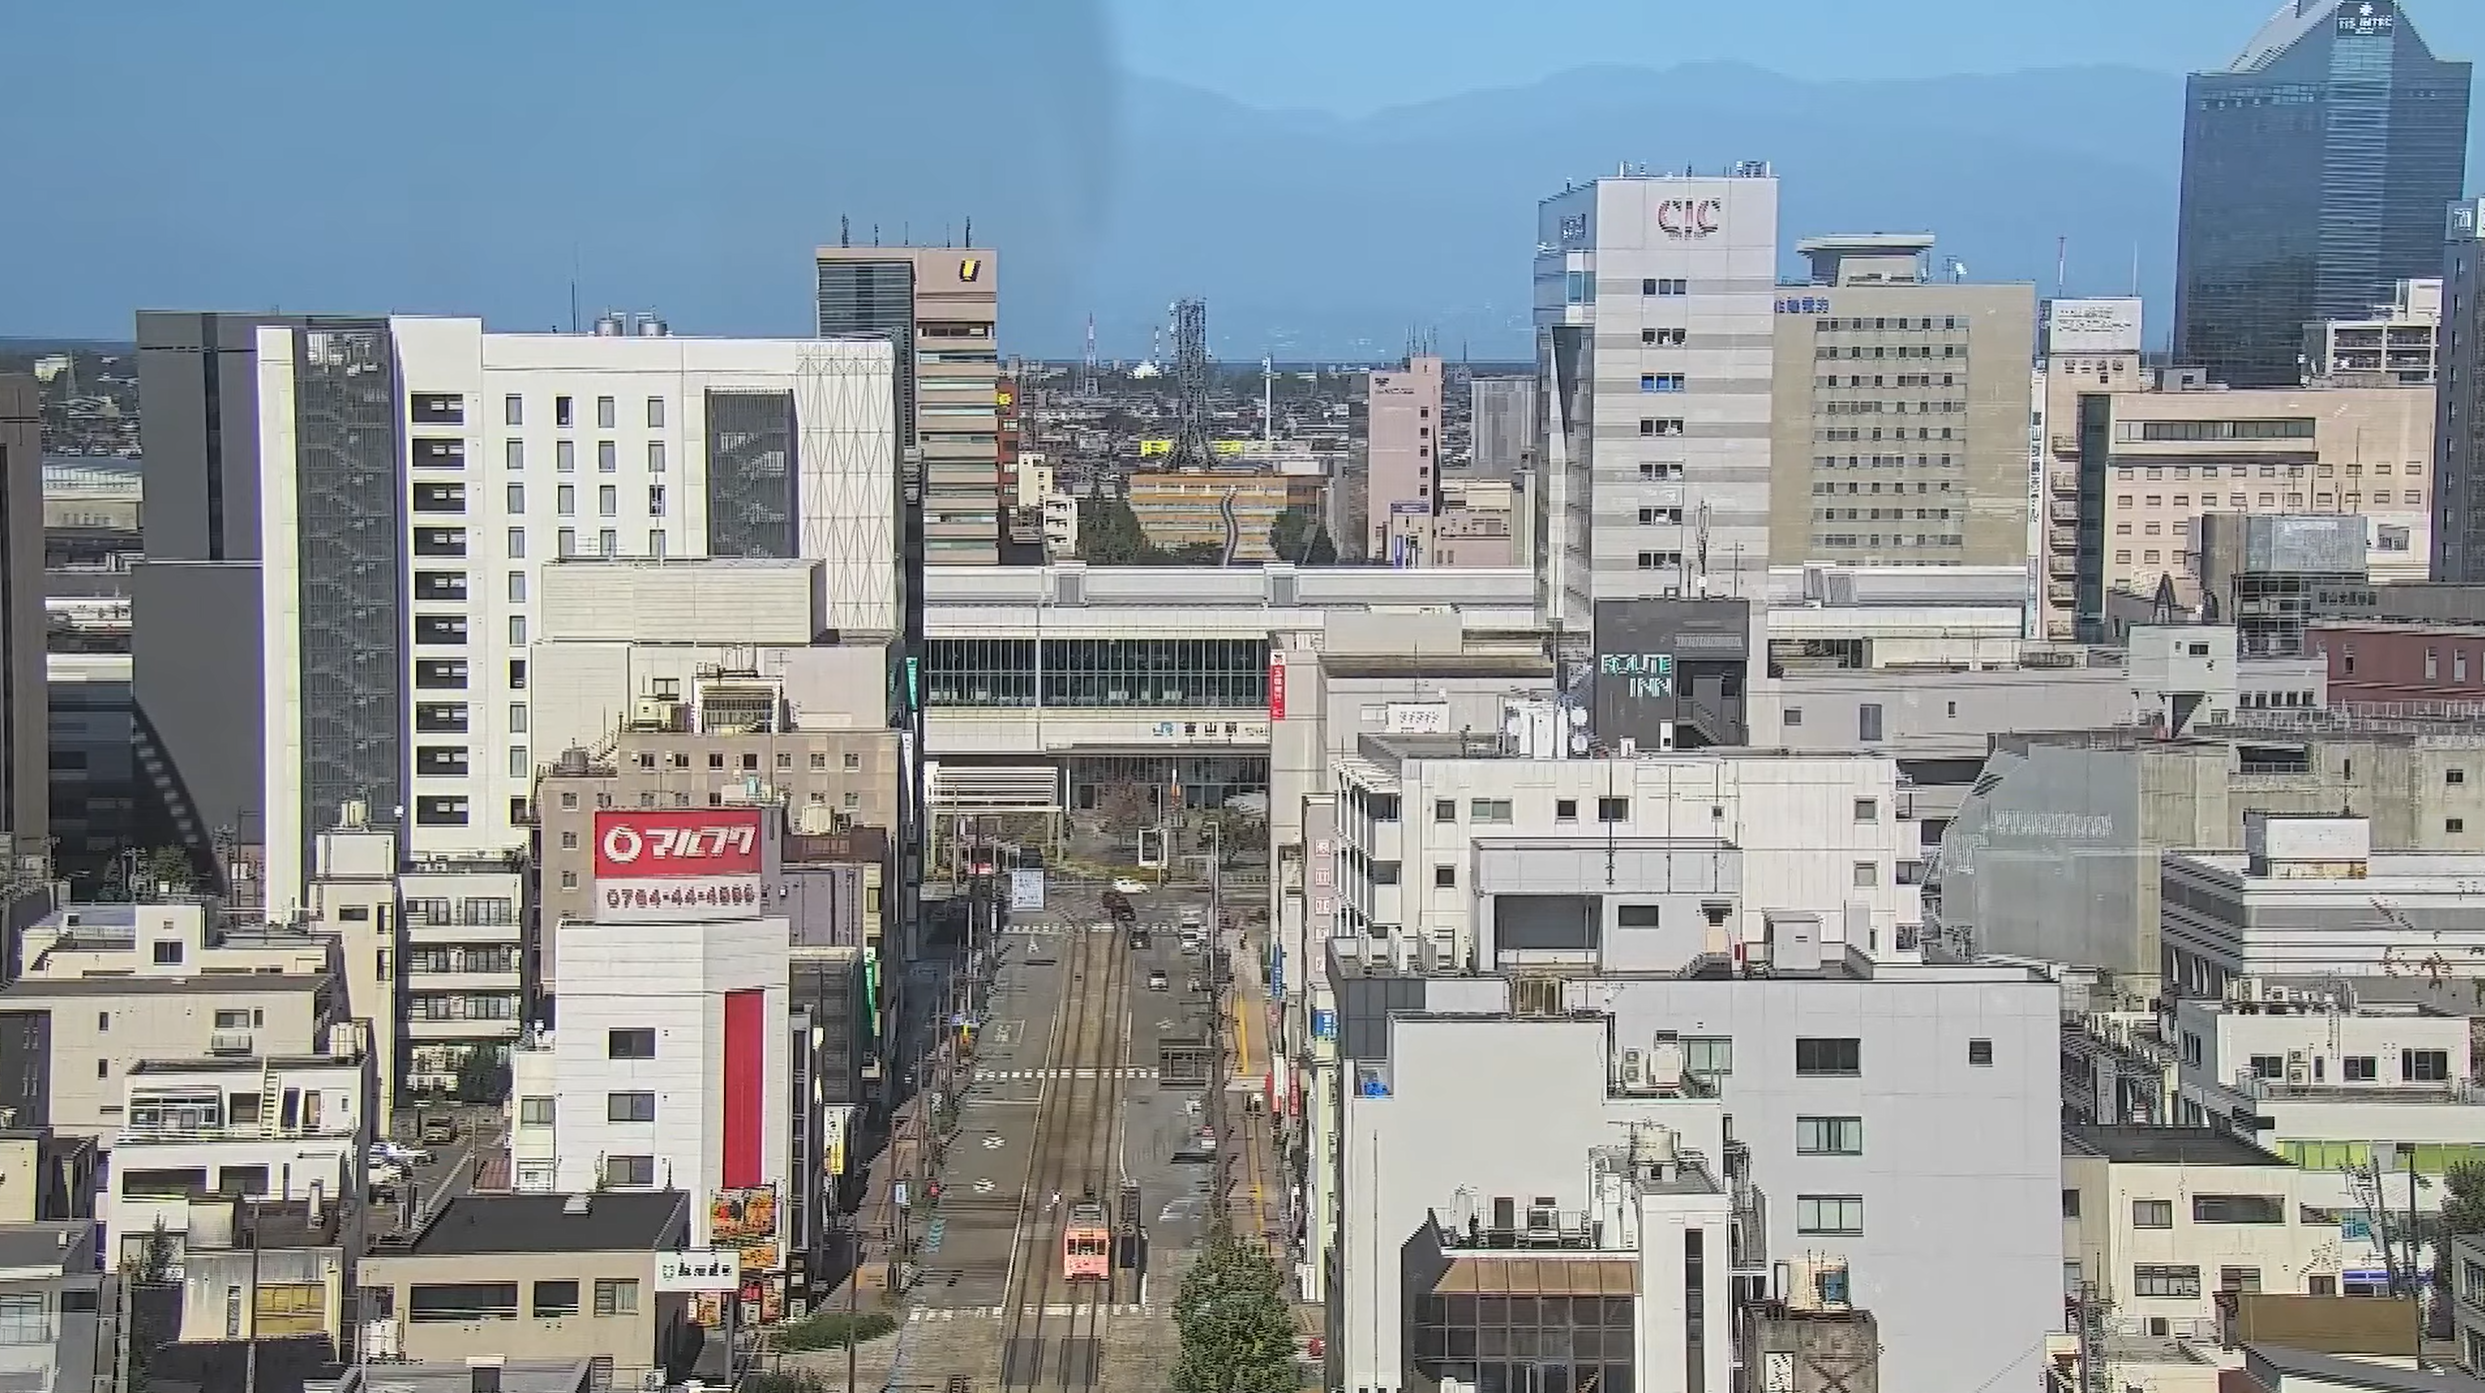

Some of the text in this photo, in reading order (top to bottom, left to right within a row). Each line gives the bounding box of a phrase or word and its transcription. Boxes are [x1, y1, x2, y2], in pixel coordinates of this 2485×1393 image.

[1657, 198, 1720, 234] CIC
[1600, 653, 1673, 674] ROUTE
[1629, 677, 1672, 698] INN
[645, 826, 757, 859] マルフク
